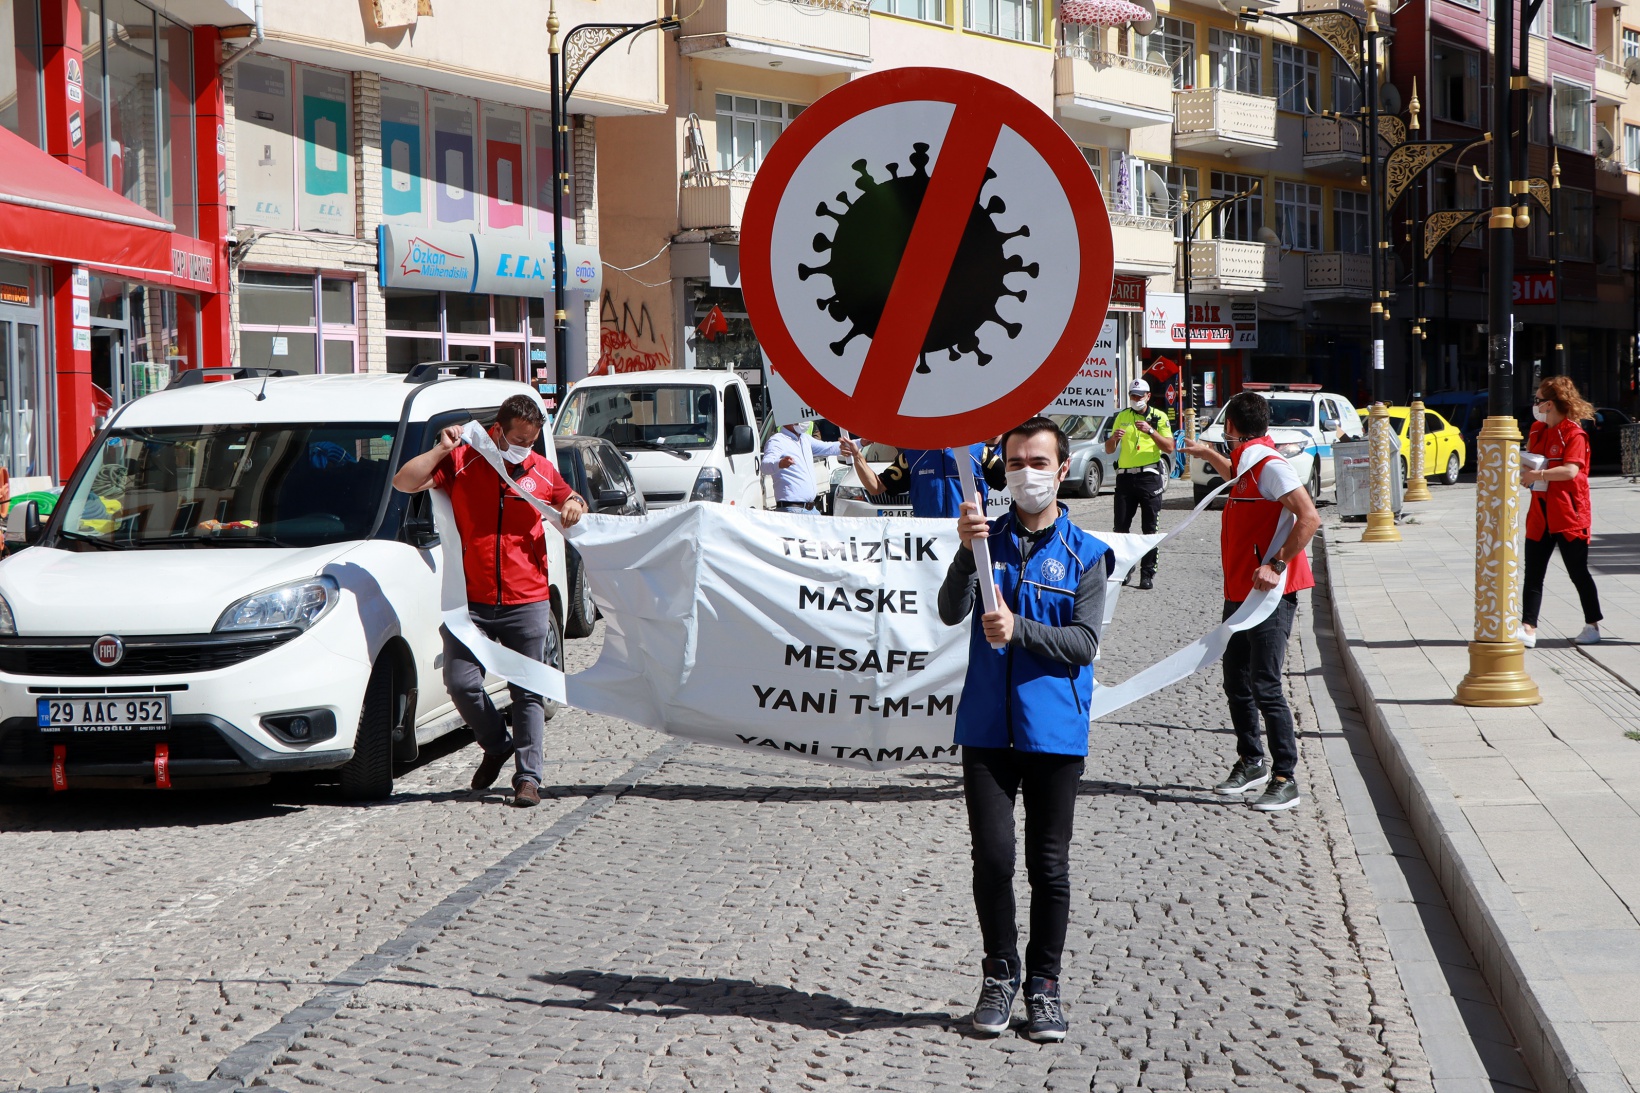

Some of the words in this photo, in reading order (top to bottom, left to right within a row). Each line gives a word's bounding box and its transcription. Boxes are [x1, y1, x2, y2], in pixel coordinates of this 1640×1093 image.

[172, 248, 187, 279] YAPI
[189, 252, 212, 284] MARKET
[412, 244, 446, 265] Özkan
[420, 265, 469, 280] Mühendislik
[576, 266, 595, 278] emas
[1512, 275, 1554, 300] BİM
[1173, 323, 1208, 339] İNAAT
[1209, 327, 1232, 339] YAPI
[1055, 398, 1104, 407] ALMASIN
[776, 533, 939, 563] TEMİZLİK
[799, 585, 918, 614] MASKE
[100, 645, 116, 658] FIAT
[785, 645, 928, 673] MESAFE
[752, 685, 837, 714] YANİ
[51, 703, 74, 722] 29
[83, 702, 118, 722] AAC
[126, 701, 162, 721] 952
[735, 734, 819, 755] YANİ
[831, 745, 959, 761] TAMAM
